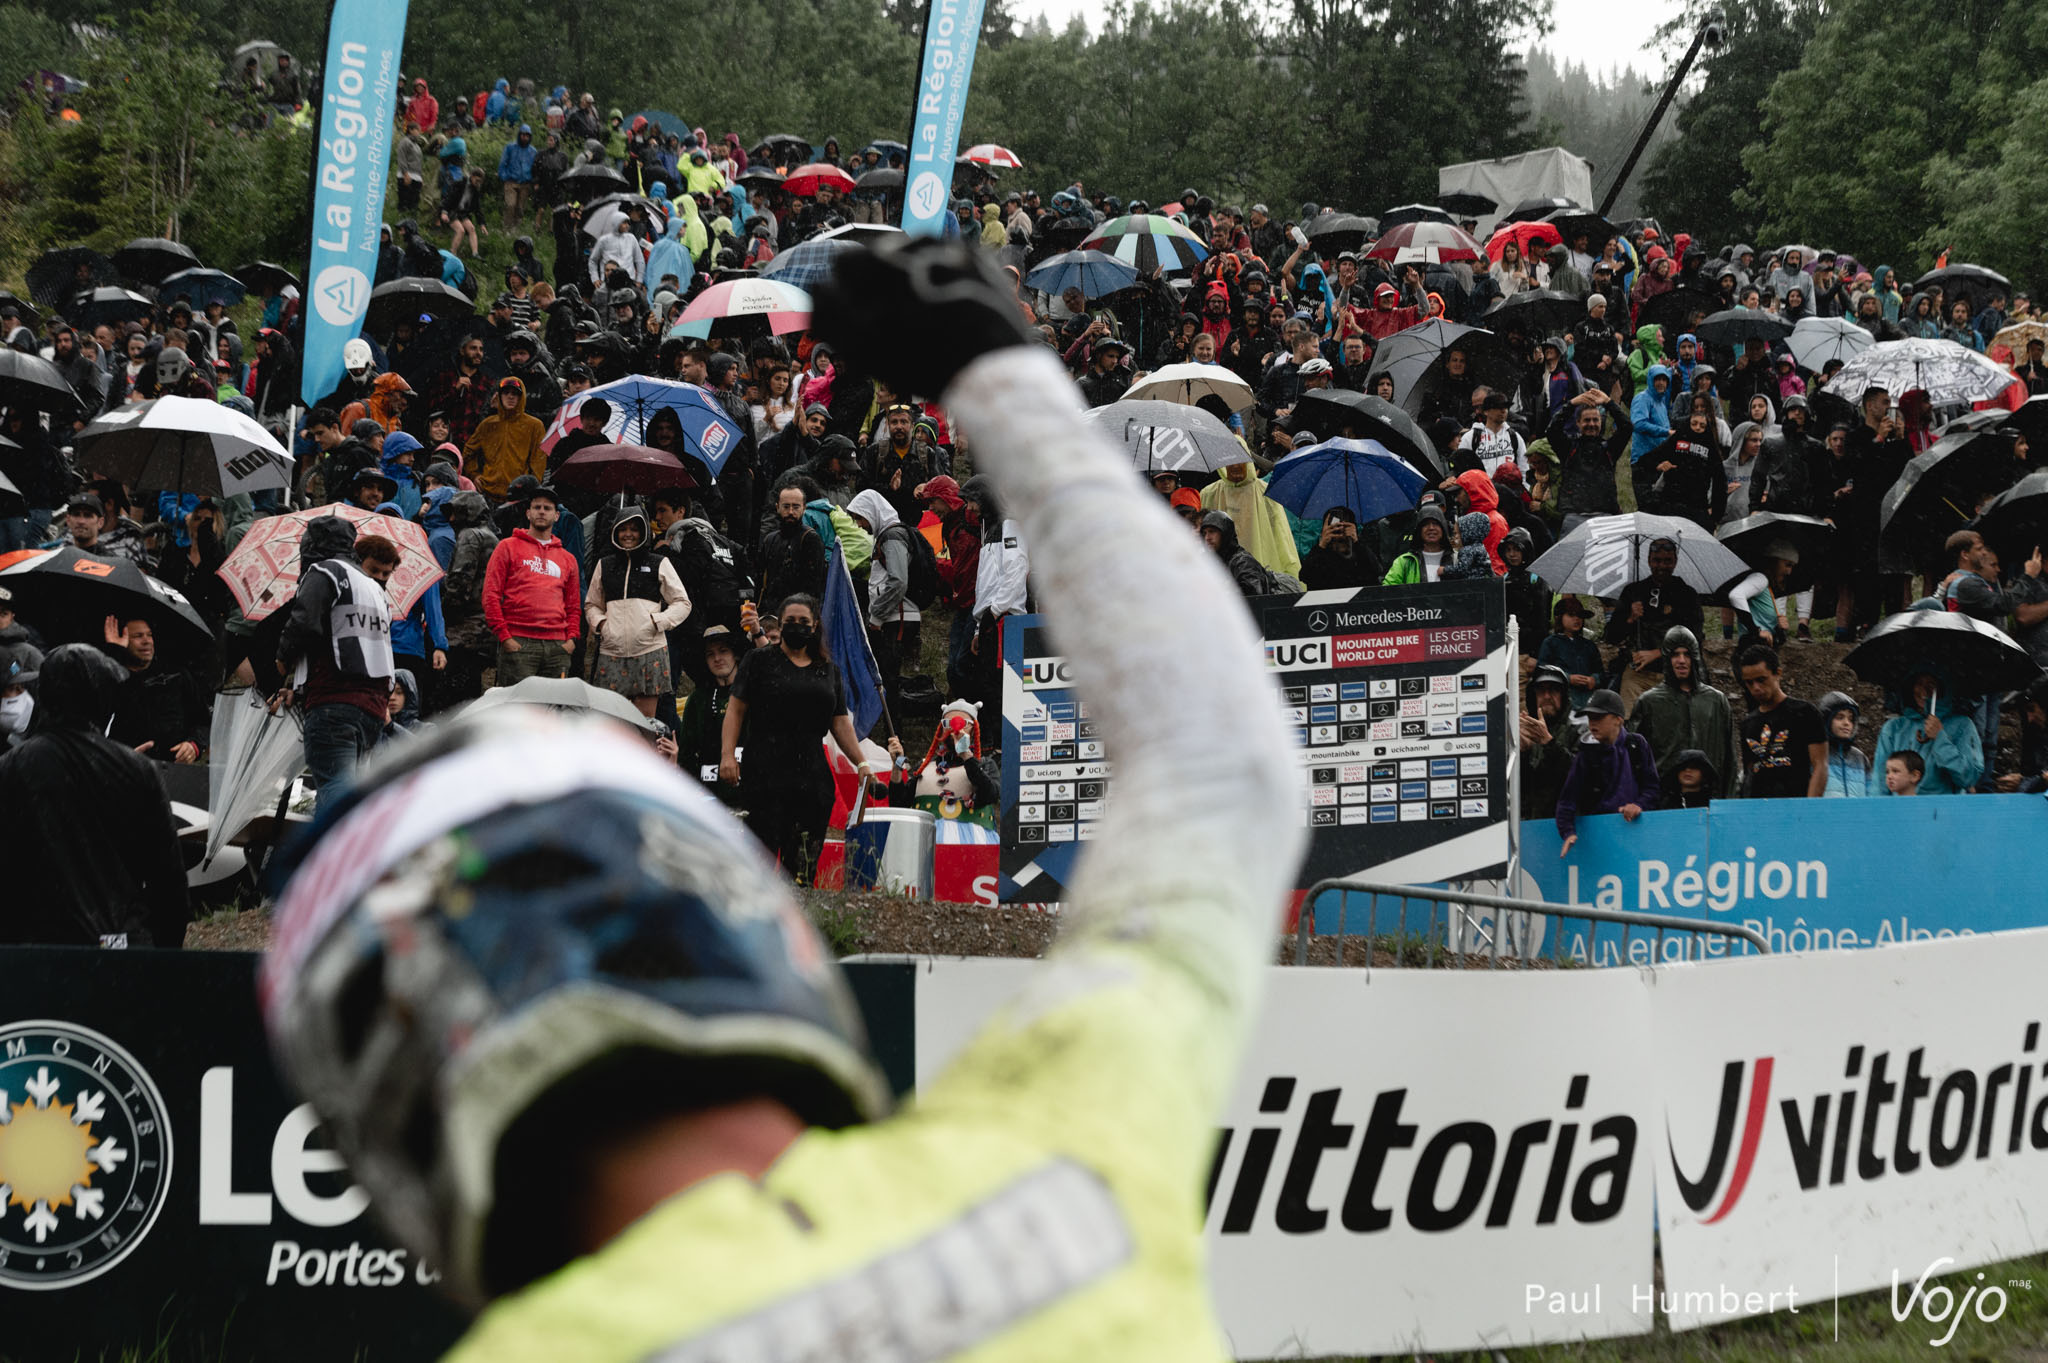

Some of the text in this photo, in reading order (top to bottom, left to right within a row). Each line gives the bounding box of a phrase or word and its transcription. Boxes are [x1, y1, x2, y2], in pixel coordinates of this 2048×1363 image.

[318, 41, 368, 253] La Région
[359, 48, 394, 253] Auvergne-Rhône-Alpes
[913, 122, 938, 163] La
[1335, 607, 1443, 628] Mercedes-Benz
[1336, 634, 1420, 650] MOUNTAIN BIKE
[1429, 629, 1480, 643] LES GETS
[1276, 642, 1327, 667] UCI
[1337, 648, 1399, 663] WORLD CUP
[1430, 643, 1472, 656] FRANCE
[1034, 662, 1073, 684] UC
[1391, 744, 1430, 754] ucichannel
[1456, 741, 1481, 751] uci.org
[1037, 769, 1062, 777] uci.org
[1568, 847, 1828, 912] La Région
[266, 1241, 407, 1287] Portes
